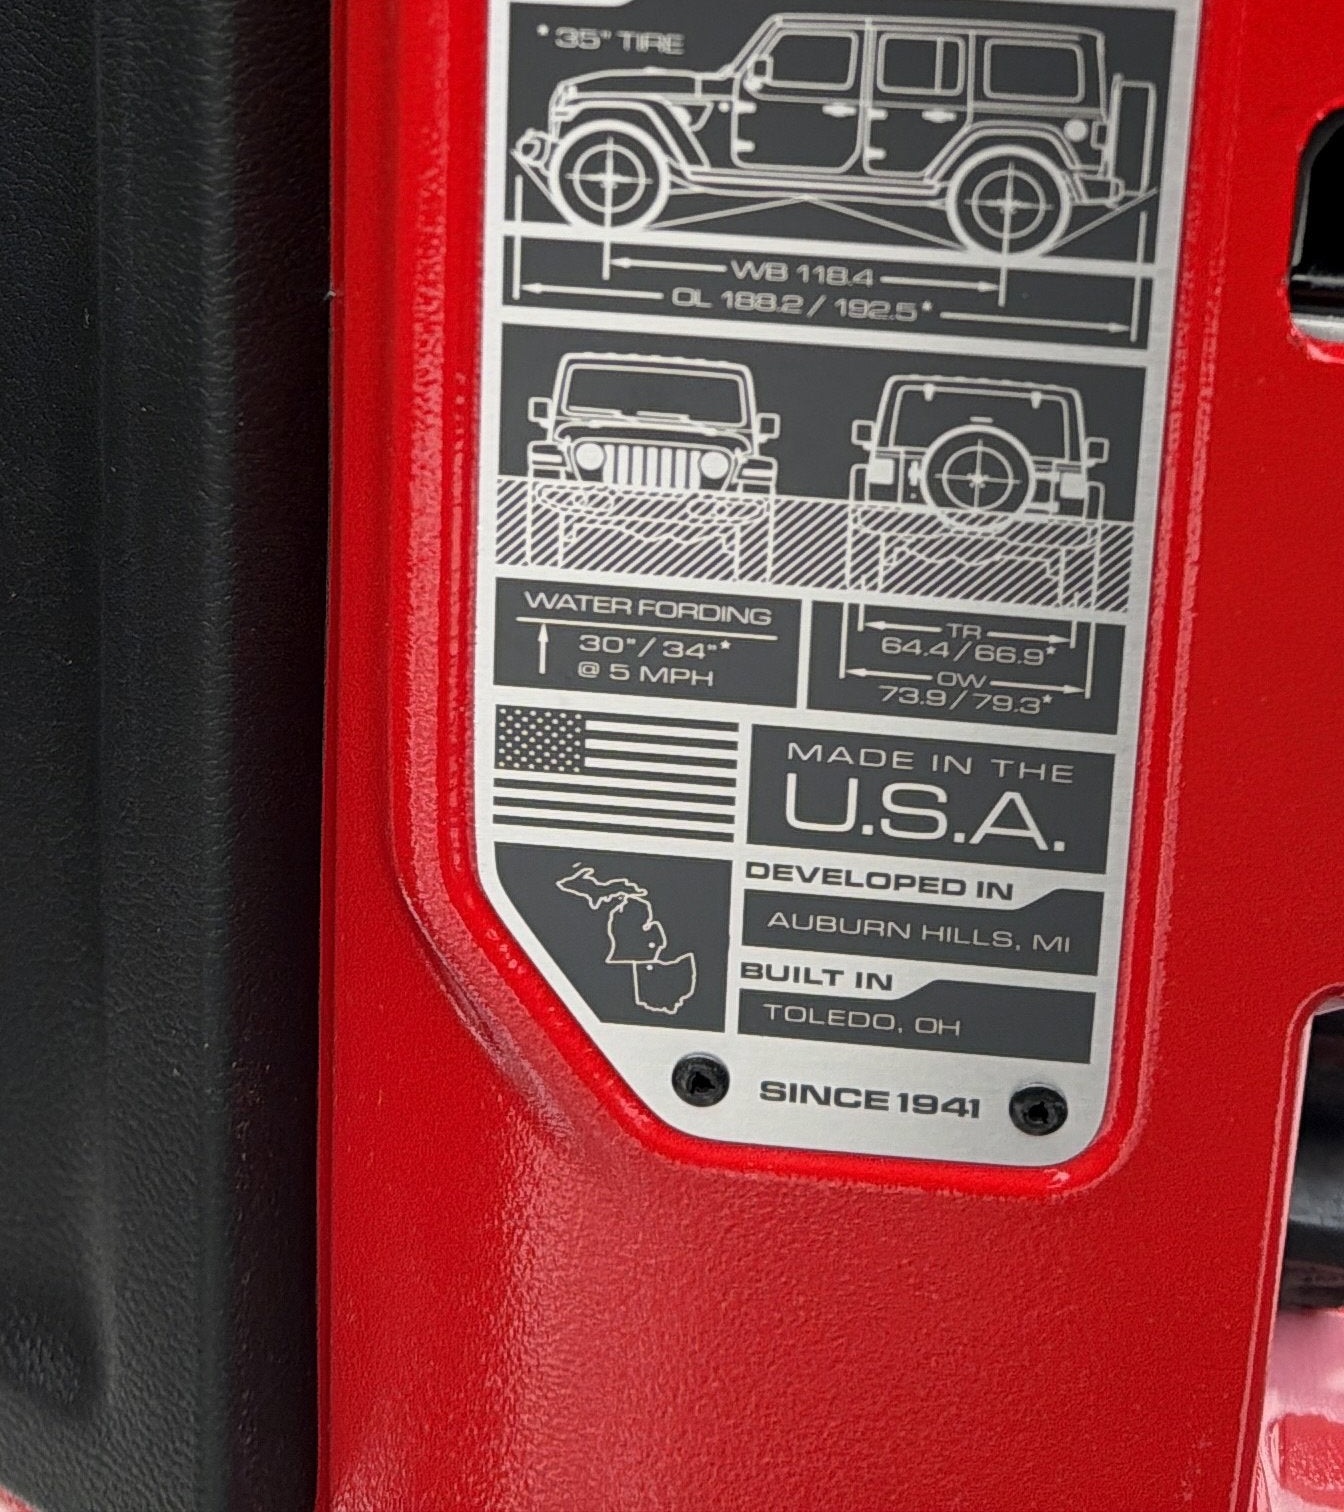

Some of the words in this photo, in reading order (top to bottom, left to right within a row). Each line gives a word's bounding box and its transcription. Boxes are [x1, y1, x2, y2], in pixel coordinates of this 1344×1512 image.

[615, 30, 685, 55] TIRE
[730, 260, 788, 282] WB
[797, 264, 874, 288] 118.4
[672, 288, 712, 308] OL
[721, 291, 804, 314] 188.2
[524, 591, 632, 615] WATER
[638, 599, 772, 626] FORDING
[946, 623, 983, 639] TR
[577, 662, 601, 678] @
[609, 664, 630, 681] 5
[639, 666, 714, 687] MPH
[936, 671, 988, 689] OW
[787, 742, 914, 771] MADE
[932, 754, 972, 775] IN
[990, 758, 1074, 784] THE
[785, 772, 1066, 852] U.S.A.
[745, 861, 966, 897] DEVELOPED
[977, 880, 1013, 901] IN
[767, 911, 912, 940] AUBURN
[921, 924, 1022, 951] HILLS,
[1032, 934, 1071, 953] MI
[740, 962, 844, 987] BUILT
[855, 971, 893, 991] IN
[763, 1003, 904, 1034] TOLEDO,
[914, 1017, 961, 1036] OH
[759, 1080, 890, 1112] SINCE
[896, 1093, 981, 1119] 1941
